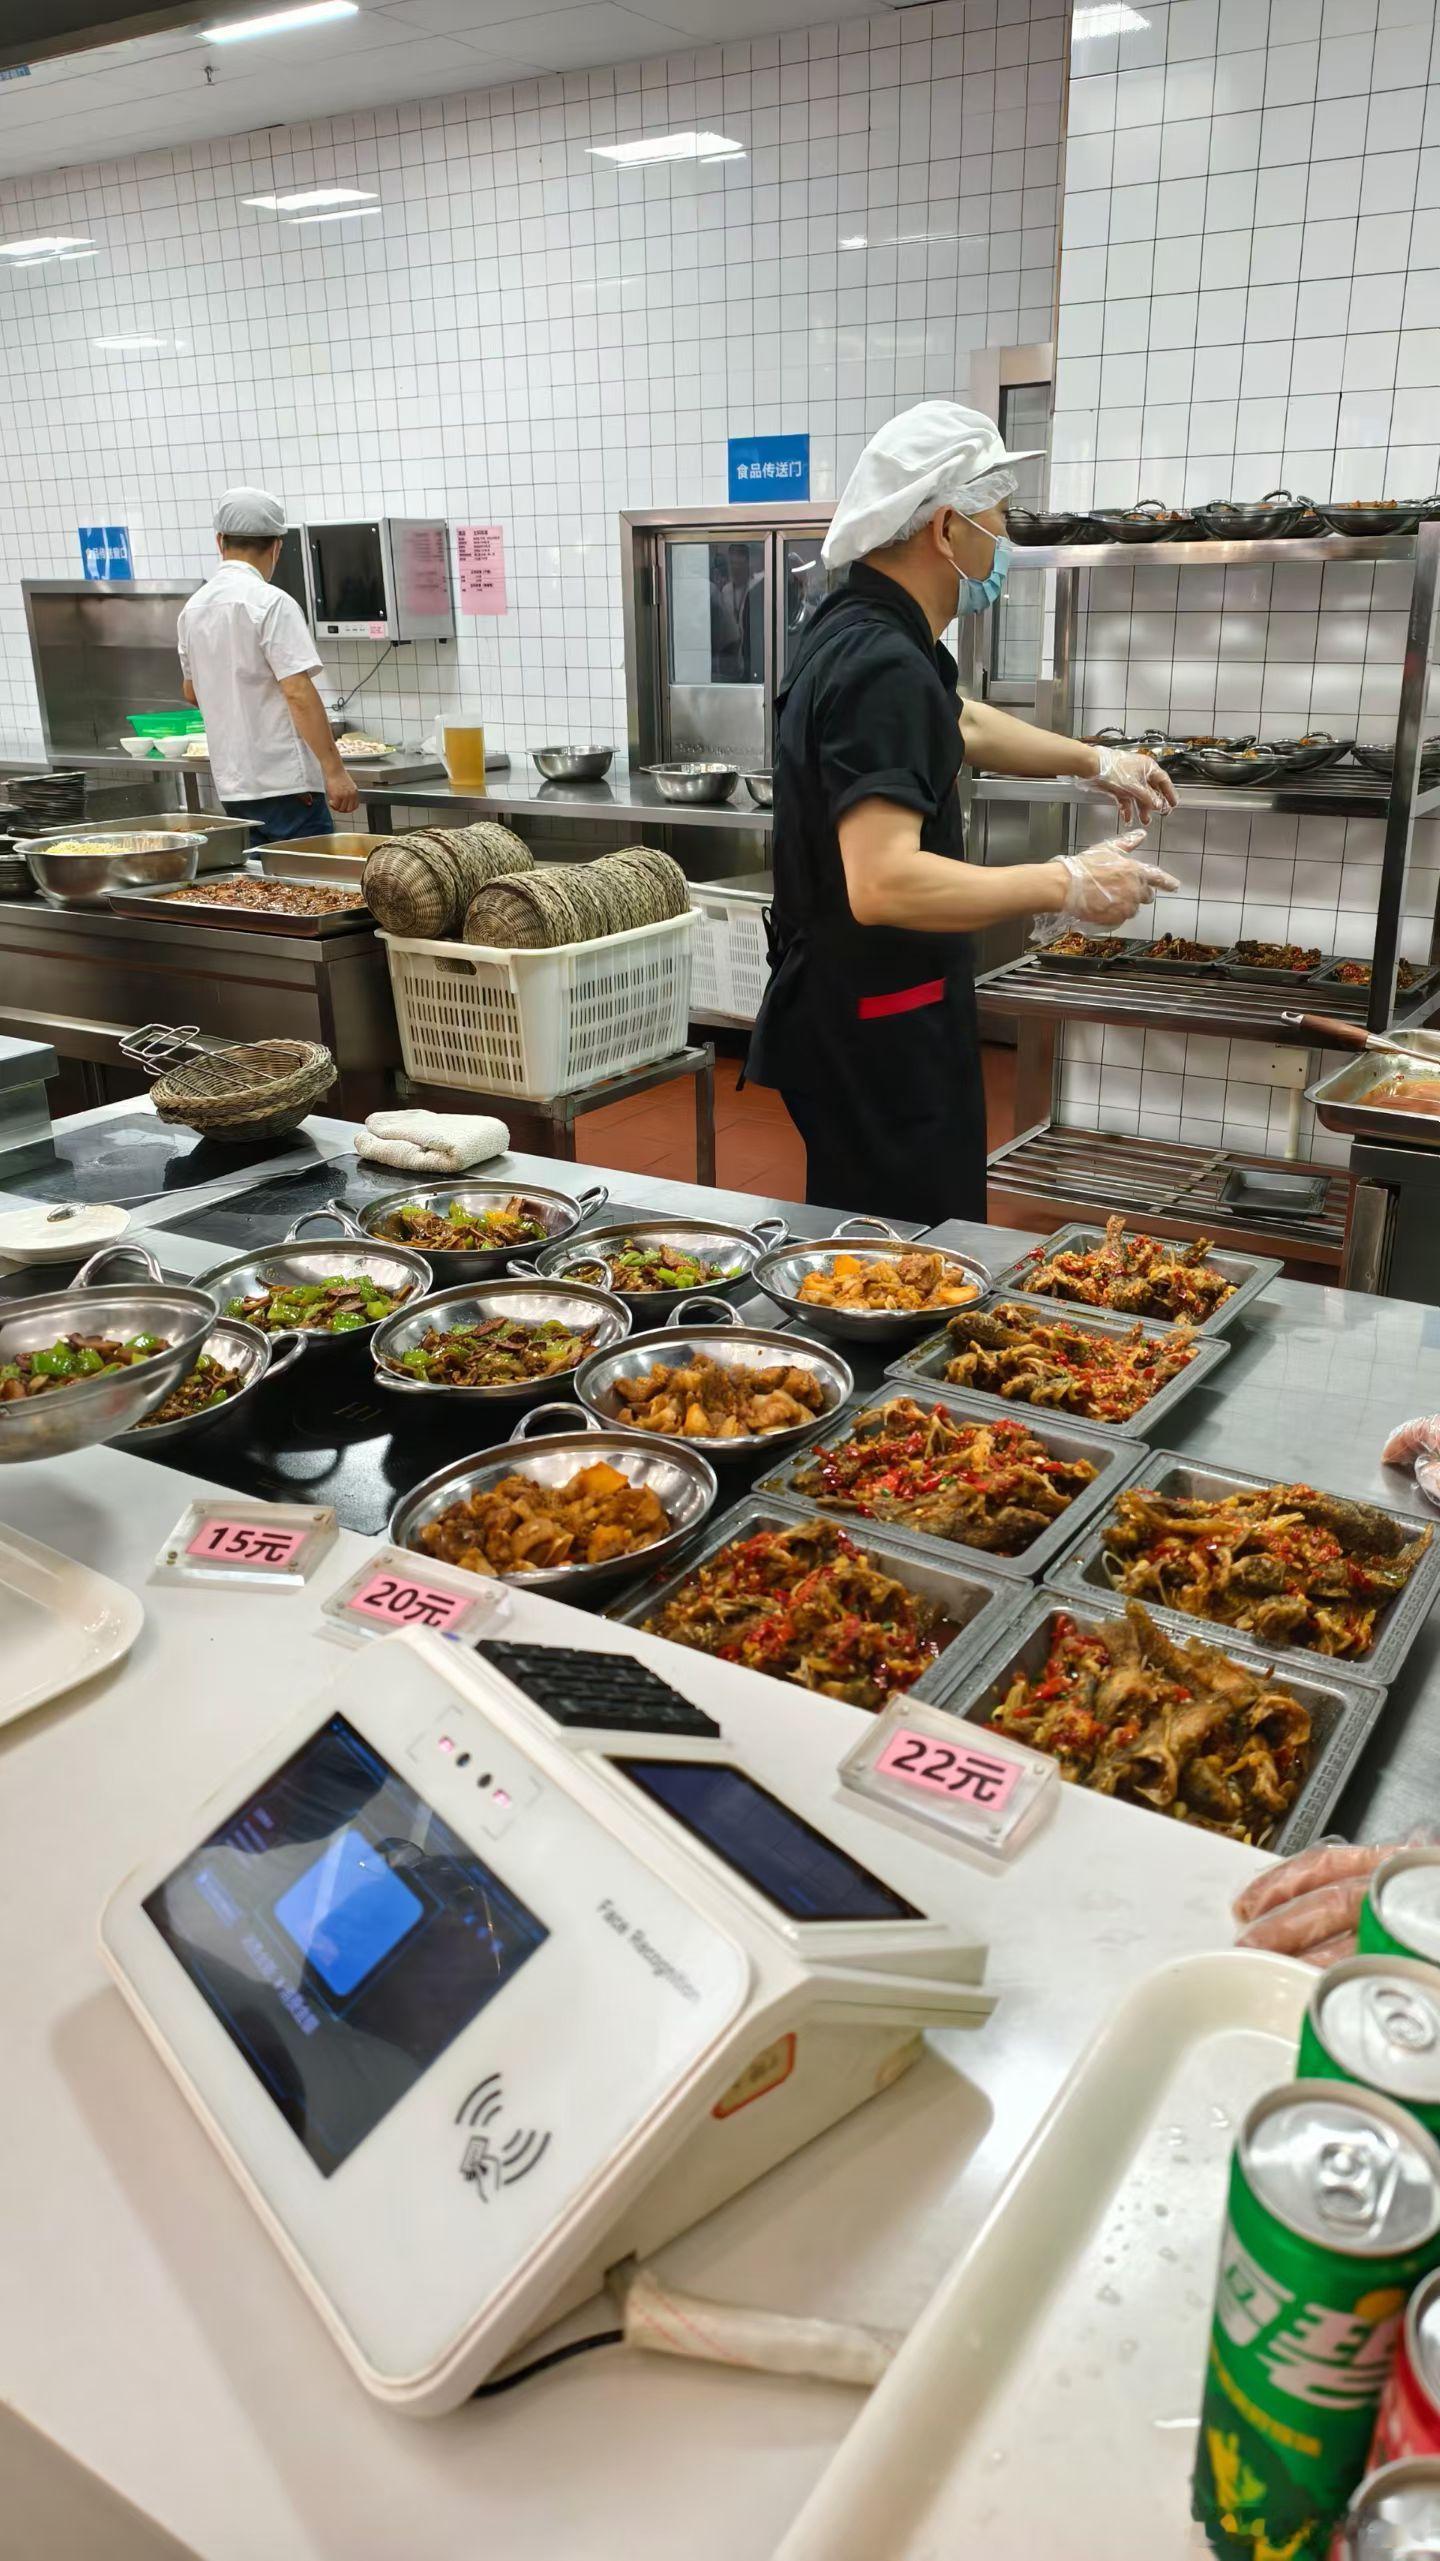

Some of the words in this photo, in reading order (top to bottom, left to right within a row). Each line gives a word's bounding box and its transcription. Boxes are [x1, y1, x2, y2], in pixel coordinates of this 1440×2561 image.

[736, 460, 802, 479] 食品传送门
[207, 1526, 293, 1562] 15元
[363, 1580, 456, 1628] 20元
[891, 1739, 1007, 1802] 22元
[596, 1899, 630, 1935] Face
[628, 1929, 702, 2003] Recognition
